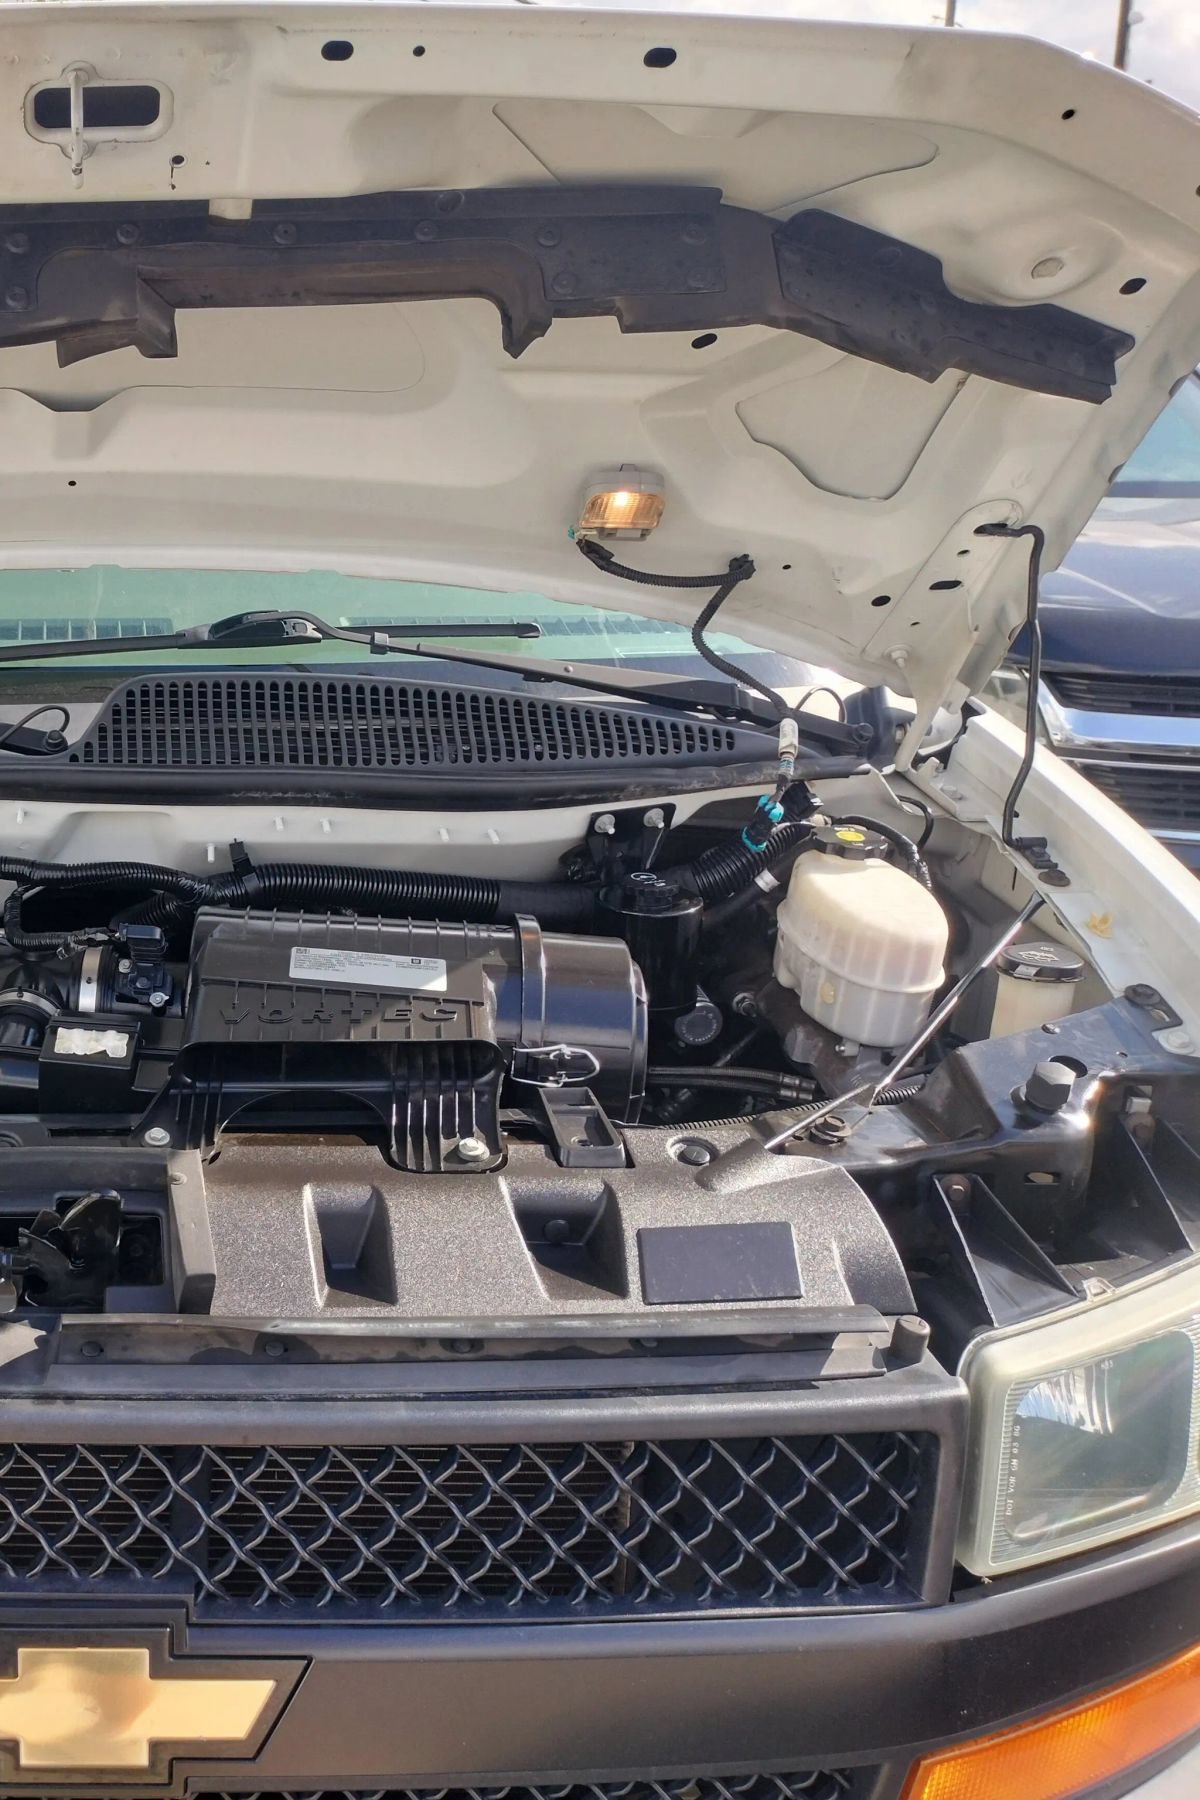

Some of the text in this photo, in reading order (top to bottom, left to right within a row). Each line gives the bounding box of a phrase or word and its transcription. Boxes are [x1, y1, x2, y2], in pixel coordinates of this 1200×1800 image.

[220, 1007, 458, 1025] VORTEC
[1008, 1476, 1016, 1493] VOR
[1006, 1499, 1014, 1516] DOT
